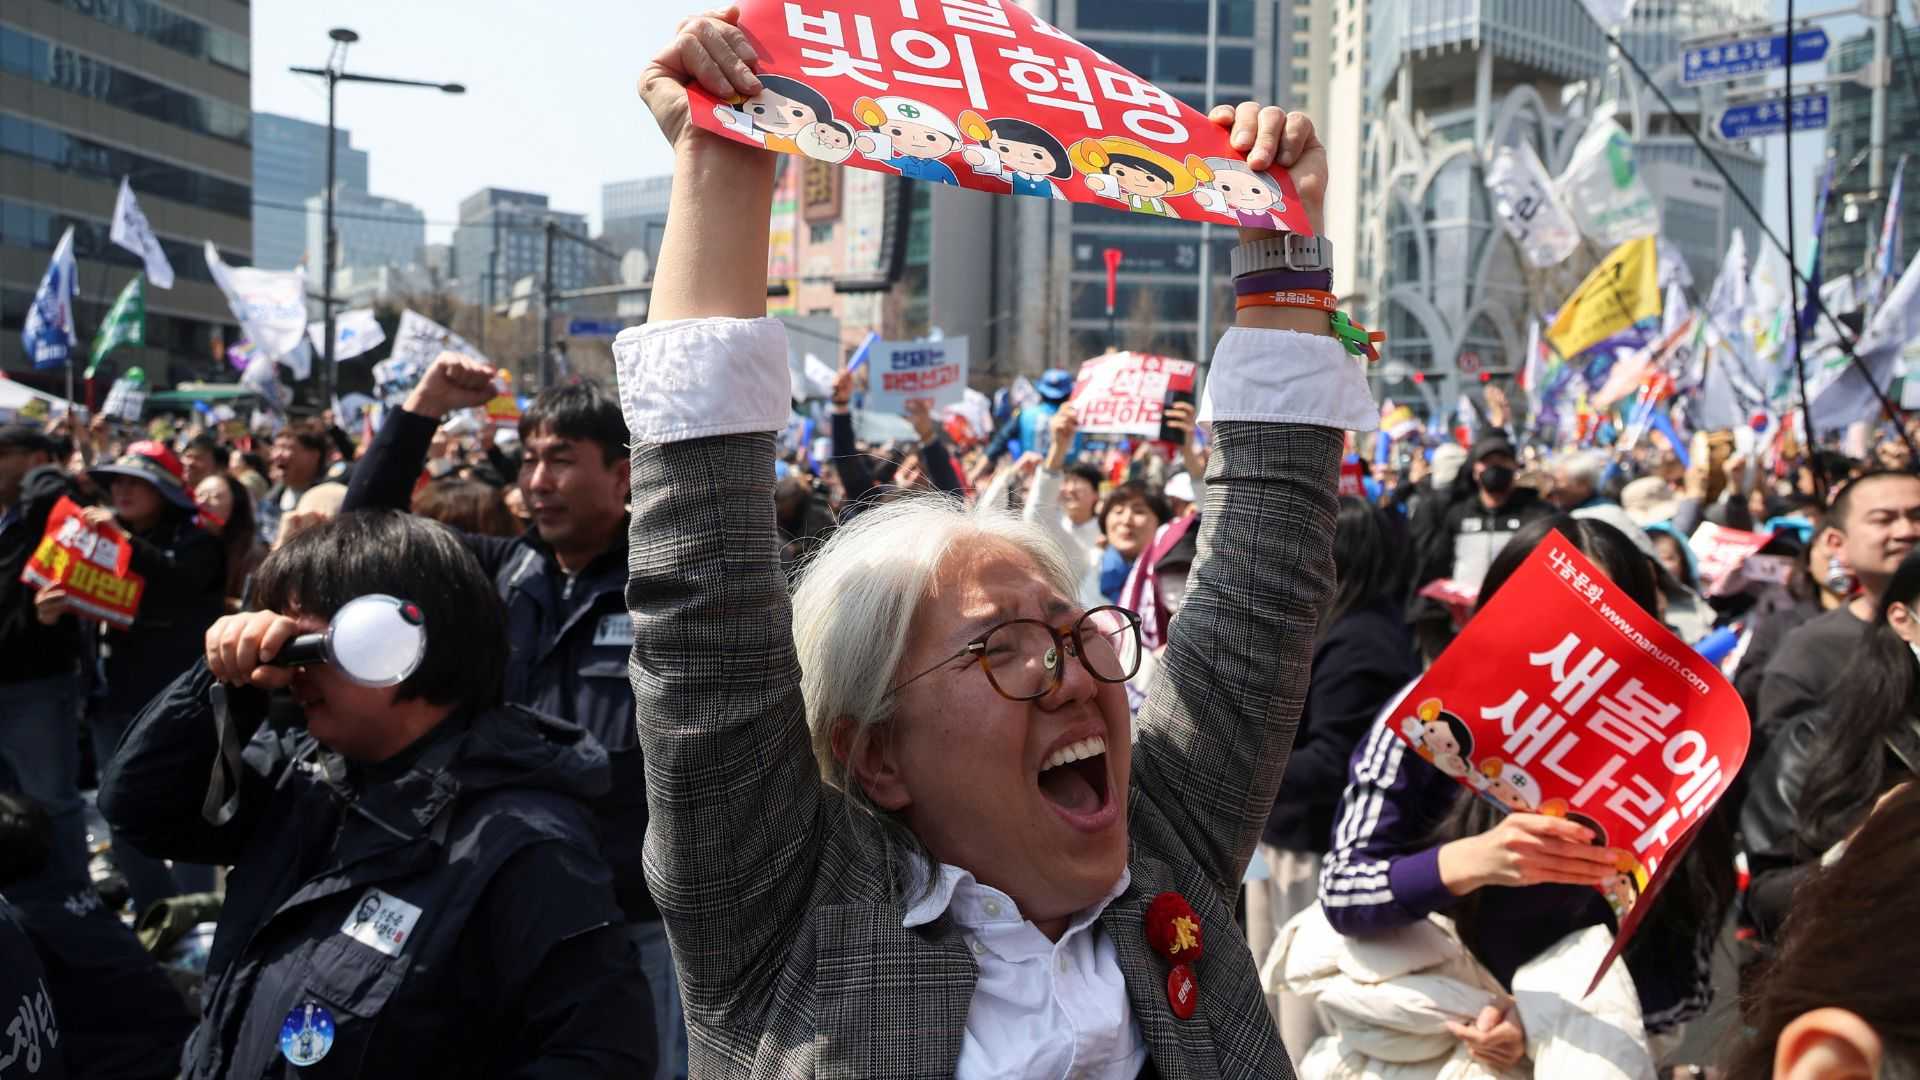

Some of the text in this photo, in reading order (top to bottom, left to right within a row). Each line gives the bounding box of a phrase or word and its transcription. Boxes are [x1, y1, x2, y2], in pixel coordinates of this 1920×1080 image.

[783, 2, 989, 110] 빛의
[998, 46, 1189, 144] 혁명
[1548, 547, 1711, 696] 나눔문화 www.nanum.com
